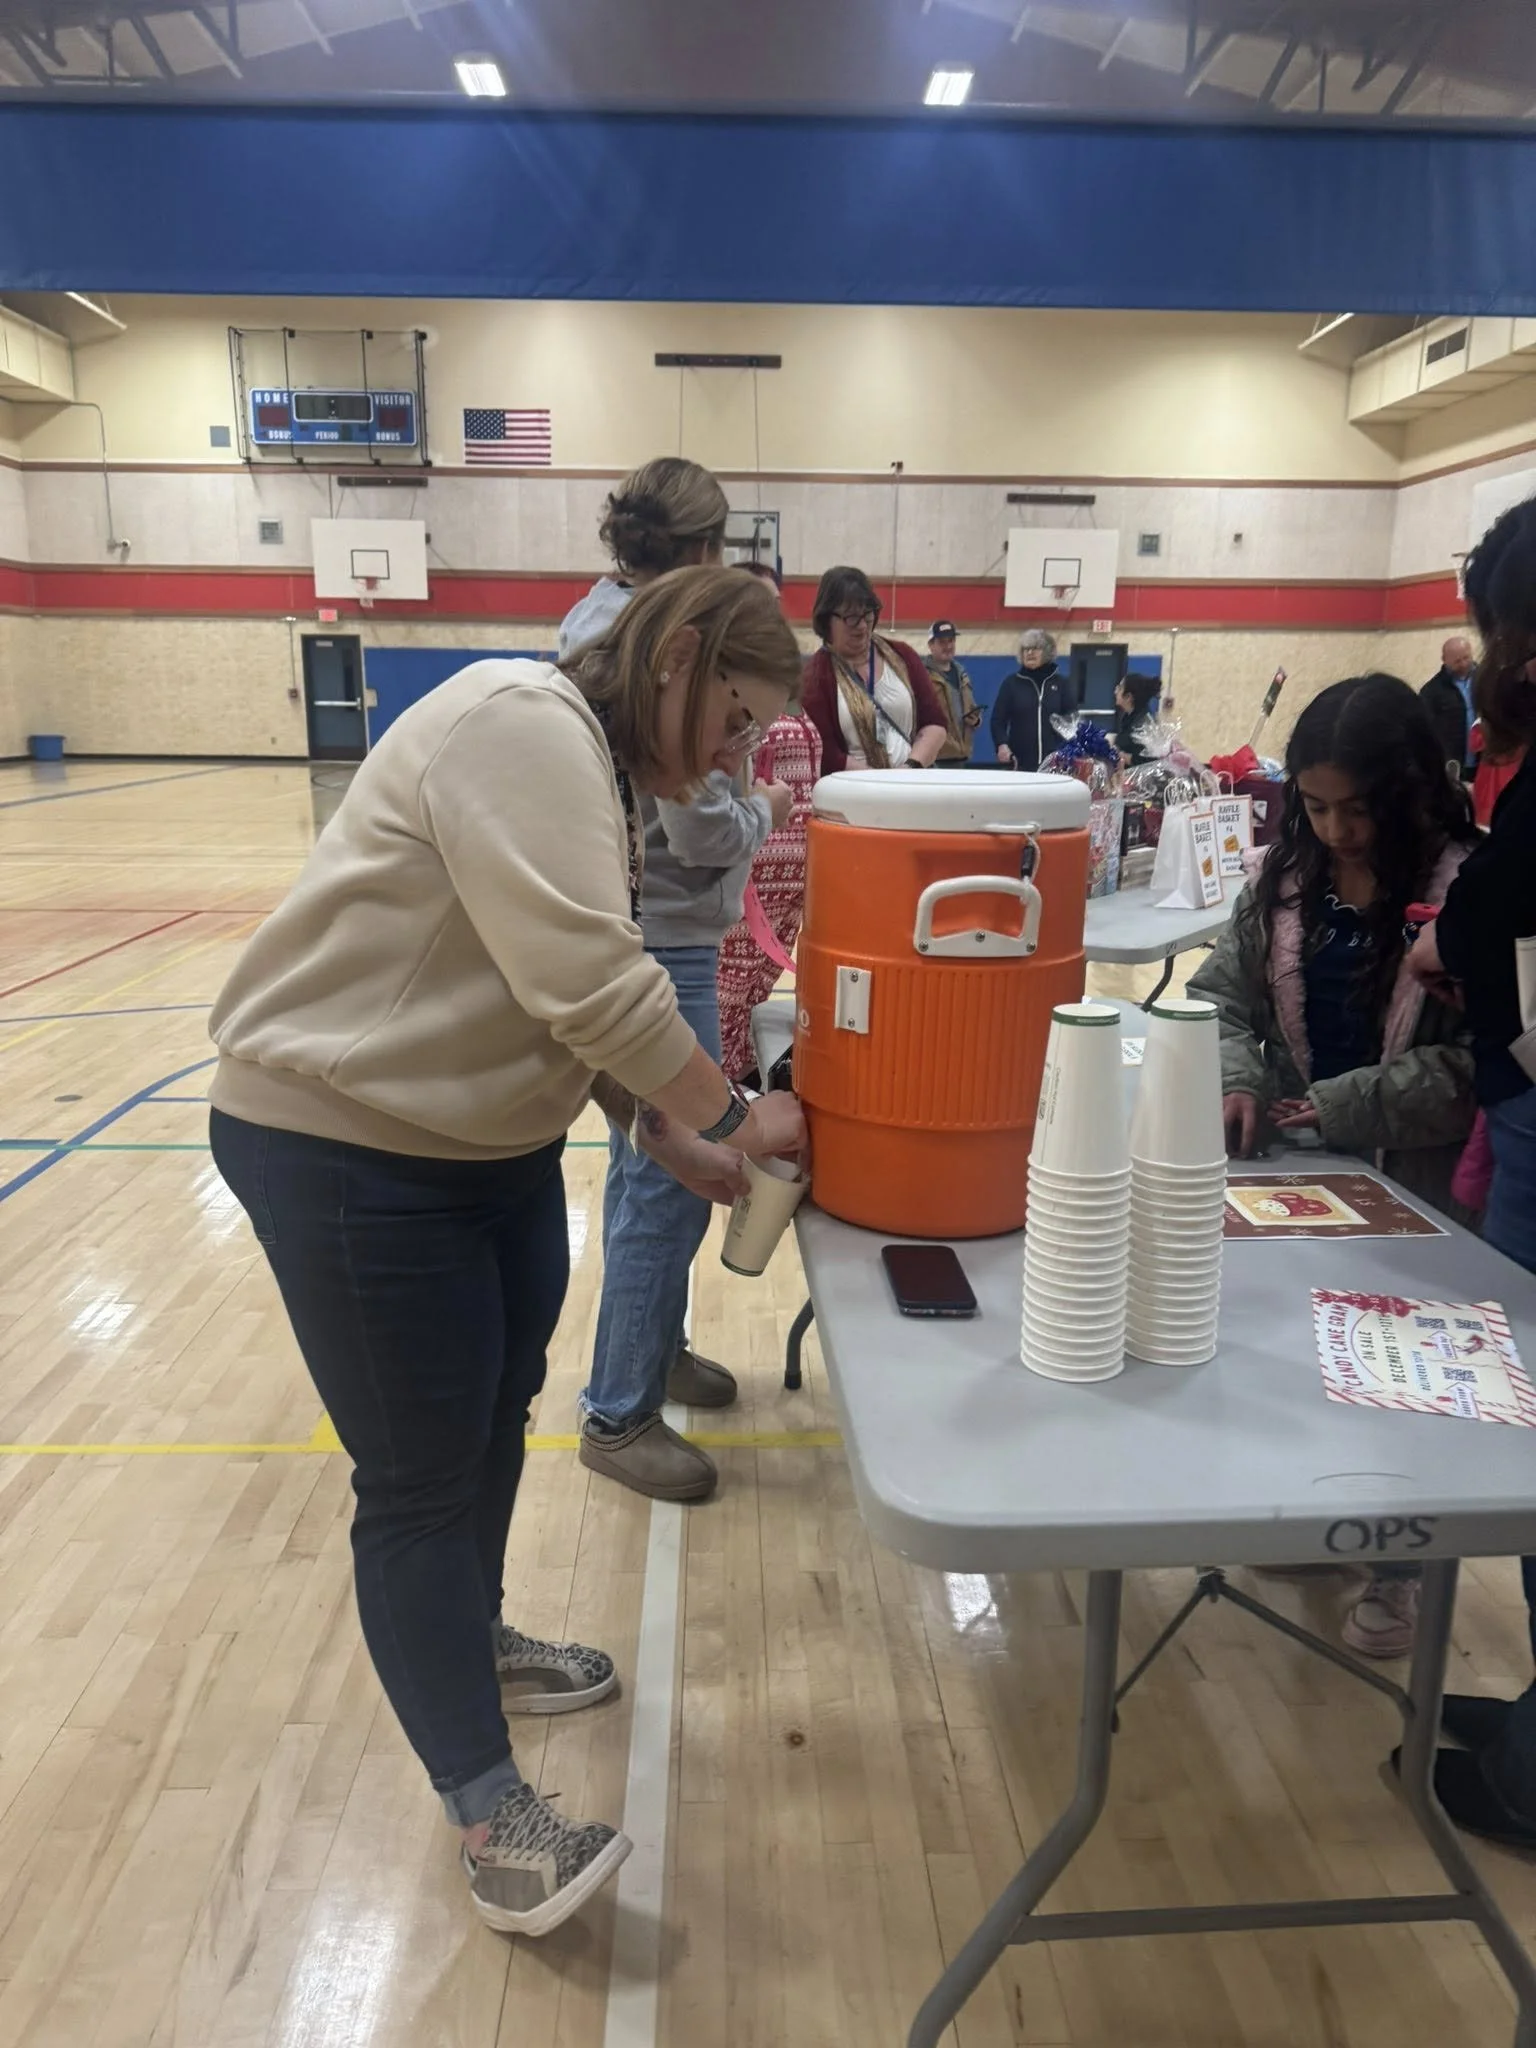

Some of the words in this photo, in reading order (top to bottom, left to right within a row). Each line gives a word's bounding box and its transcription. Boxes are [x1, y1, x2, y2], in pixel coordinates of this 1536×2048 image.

[255, 393, 289, 404] HOME
[374, 394, 411, 406] VISITOR
[315, 431, 339, 440] PERIOD
[375, 432, 401, 441] BONUS
[1218, 804, 1240, 814] RAFFLE
[1217, 813, 1240, 823] BASKET
[1327, 1303, 1349, 1327] GRAM
[1327, 1327, 1348, 1352] CANE
[1358, 1330, 1375, 1349] SALE
[1362, 1351, 1376, 1361] ON
[1333, 1354, 1364, 1386] CANDY
[1386, 1346, 1407, 1383] DECEMBER
[1325, 1515, 1440, 1553] OPS
